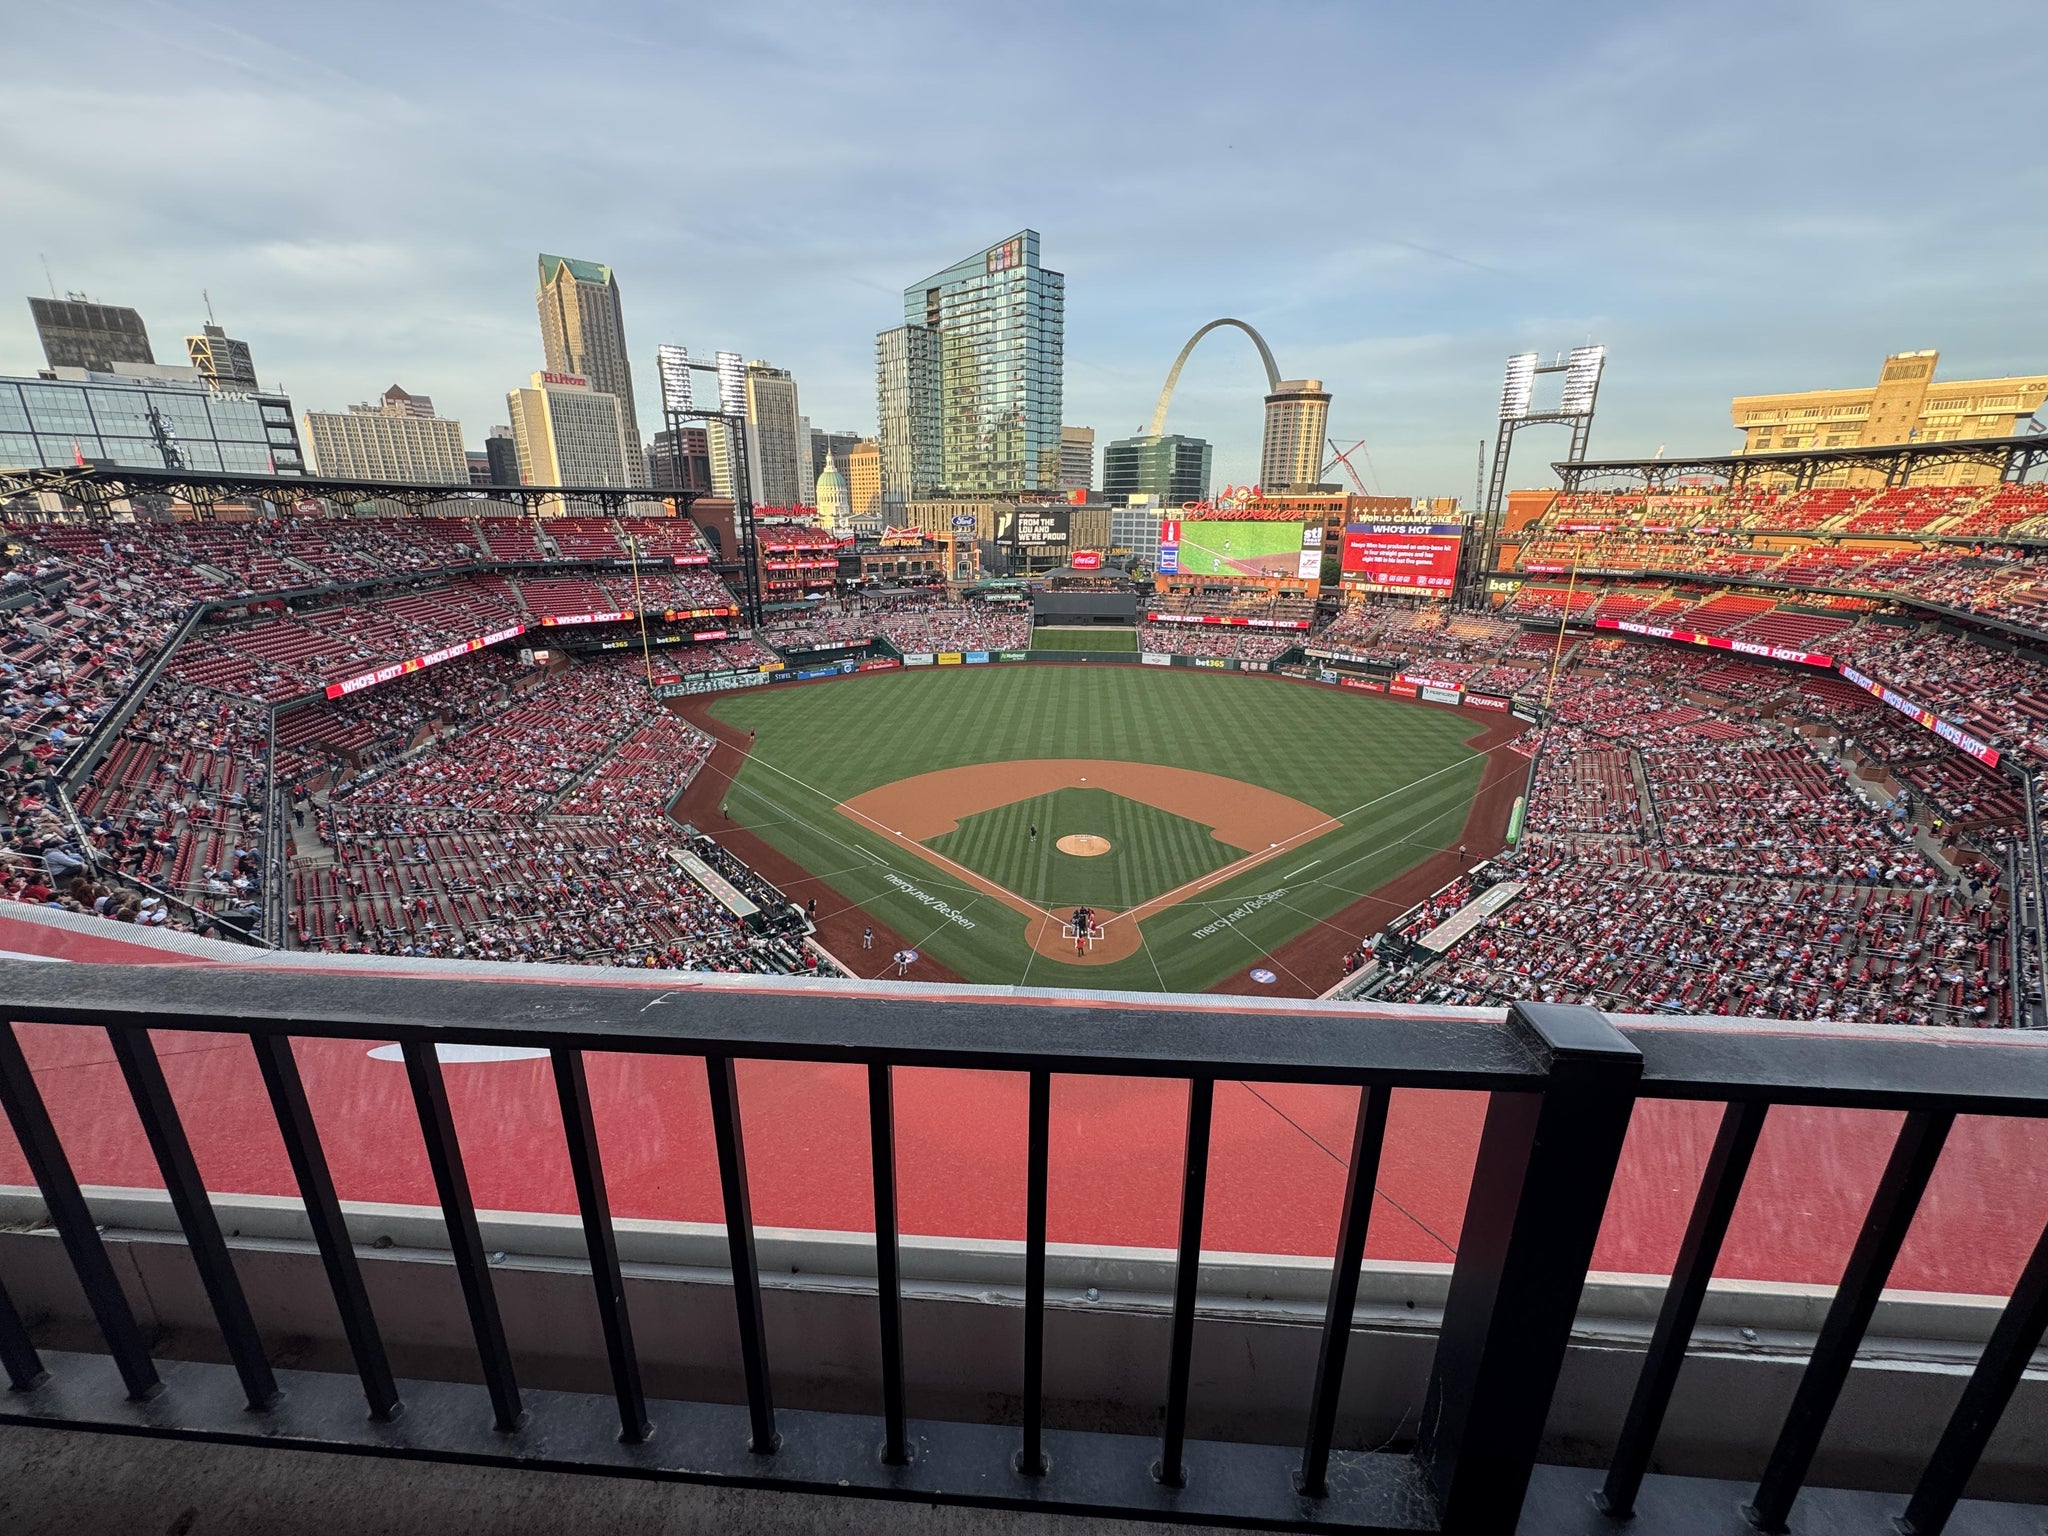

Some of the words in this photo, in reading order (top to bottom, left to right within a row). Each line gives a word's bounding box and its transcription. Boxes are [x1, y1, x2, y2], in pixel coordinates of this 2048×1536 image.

[543, 373, 586, 386] Hilton
[210, 391, 258, 404] pwc
[1182, 501, 1304, 521] Budweiser
[956, 516, 975, 526] Ford
[1359, 514, 1391, 523] WORLD
[1394, 515, 1452, 523] CHAMPIONS
[1018, 533, 1041, 541] WE'RE
[1043, 532, 1067, 540] PROUD
[1373, 526, 1405, 534] WHO'S
[1408, 527, 1432, 535] HOT
[1356, 583, 1380, 591] BROWN
[1391, 585, 1433, 595] CROUPPEN
[557, 614, 592, 625] WHO'S
[594, 612, 622, 623] HOT?
[1275, 620, 1298, 628] HOT?
[1618, 621, 1646, 635] WHO'S
[1648, 626, 1674, 638] HOT?
[483, 633, 503, 646] WHO'S
[503, 629, 519, 641] HOT?
[656, 636, 680, 644] bet365
[602, 641, 628, 649] bet365
[1731, 640, 1770, 656] WHO'S
[1772, 648, 1807, 662] HOT?
[422, 650, 448, 667] WHO'S
[449, 645, 469, 659] HOT?
[1195, 658, 1224, 667] bet365
[341, 675, 375, 693] WHO'S
[378, 666, 404, 682] HOT?
[1404, 676, 1431, 686] WHO'S
[1432, 680, 1456, 689] HOT?
[1857, 673, 1872, 689] HOT?
[1464, 695, 1506, 709] EQUIFAX
[1883, 689, 1903, 709] WHO'S
[1902, 700, 1921, 719] HOT?
[1935, 720, 1961, 744] WHO'S
[1960, 736, 1987, 759] HOT?
[883, 873, 976, 930] mercy.net/BeSeen
[1192, 888, 1289, 939] mercy.net/BeSeen
